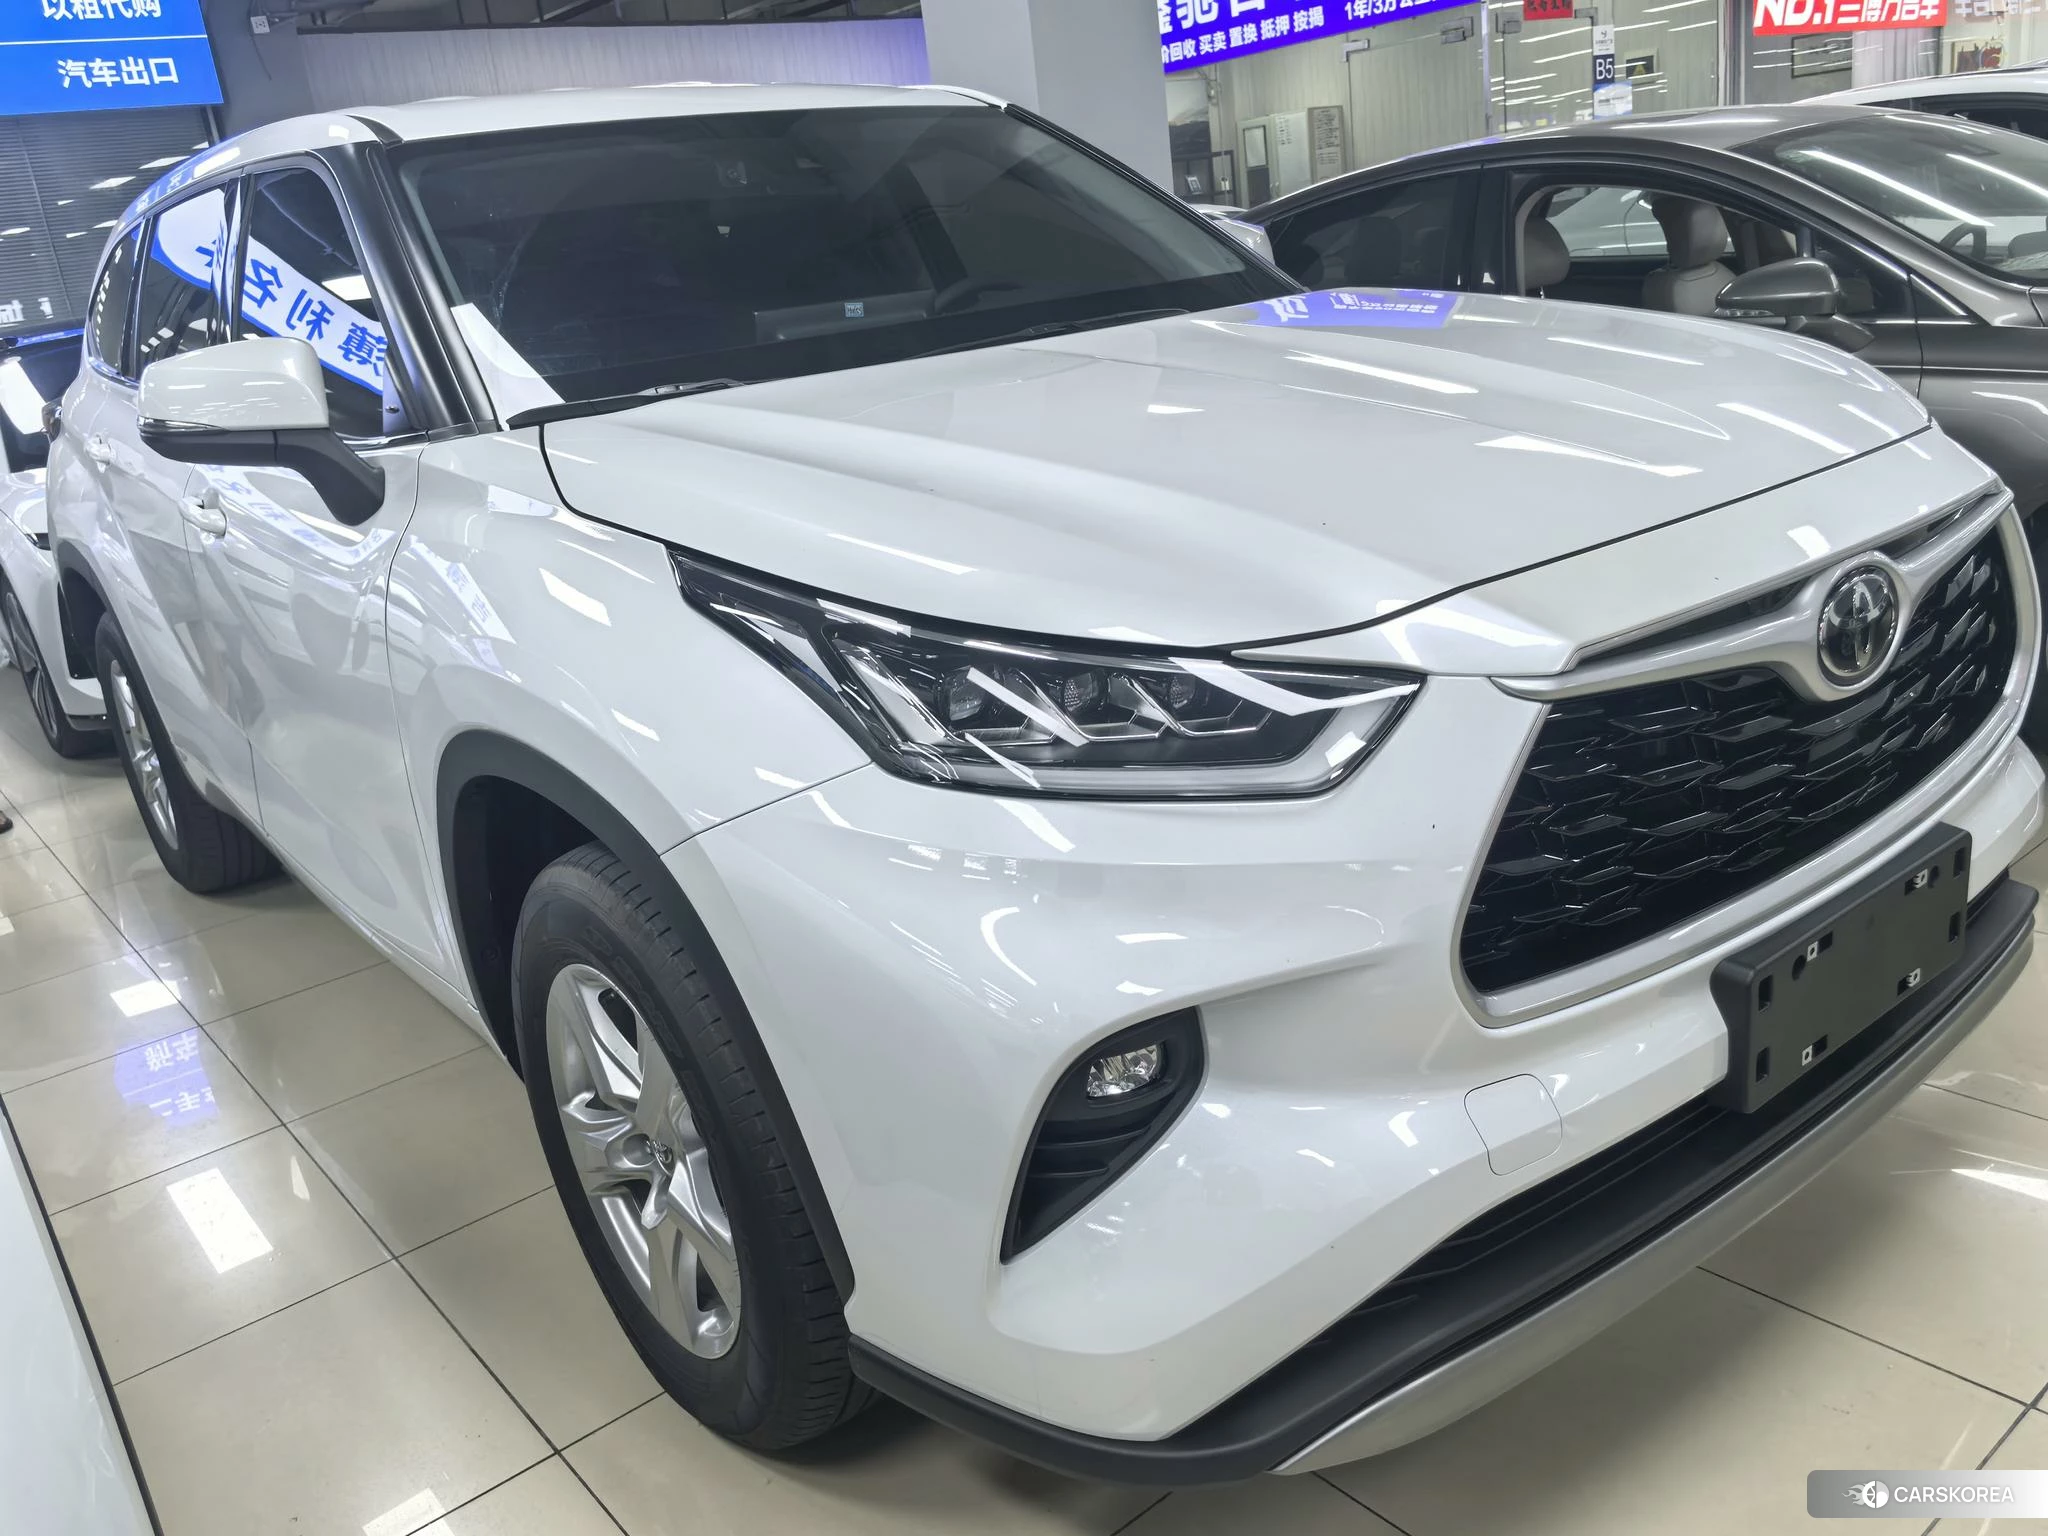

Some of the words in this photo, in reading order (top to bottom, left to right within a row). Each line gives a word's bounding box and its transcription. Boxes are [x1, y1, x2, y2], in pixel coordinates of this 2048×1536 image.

[1198, 31, 1227, 55] 买卖
[1229, 23, 1258, 48] 置换
[1260, 14, 1290, 40] 抵押
[1293, 5, 1325, 33] 按揭
[57, 57, 179, 88] 汽车出口
[1596, 58, 1614, 80] B5
